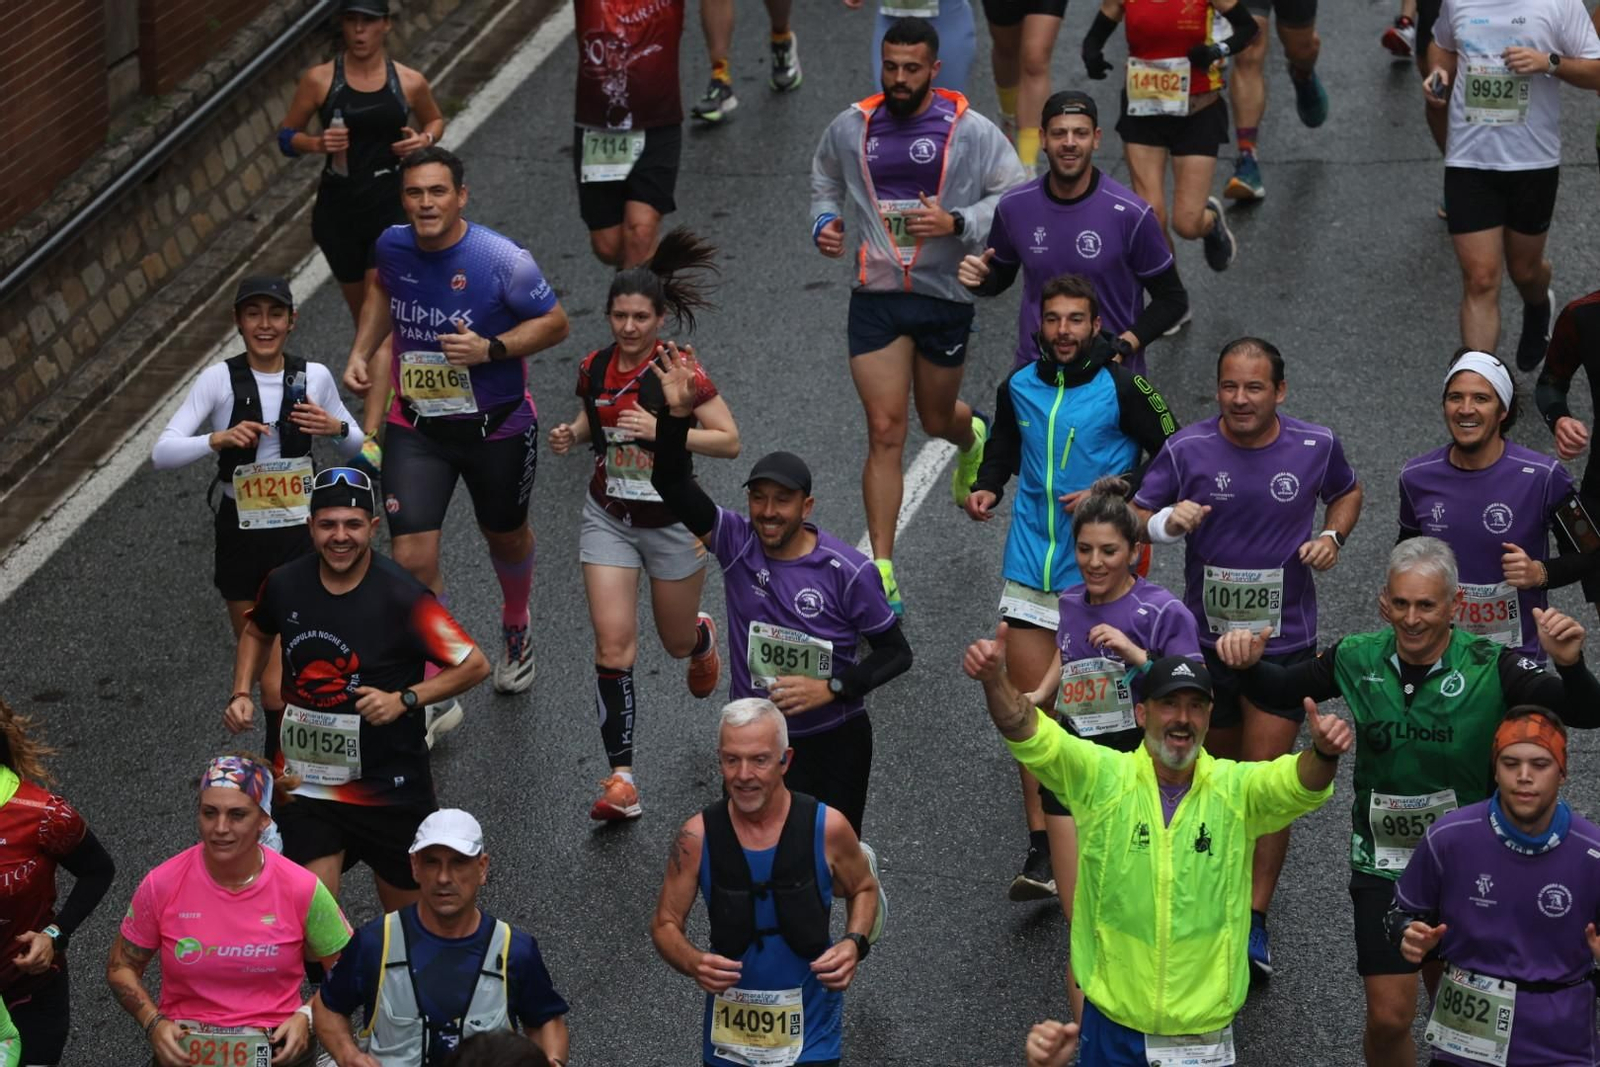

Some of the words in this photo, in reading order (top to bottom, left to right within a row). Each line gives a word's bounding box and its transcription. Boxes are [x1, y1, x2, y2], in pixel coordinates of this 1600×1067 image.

[1131, 73, 1179, 91] 14162
[1472, 79, 1514, 99] 9932
[591, 138, 629, 154] 7114
[405, 369, 459, 389] 12816
[242, 475, 302, 499] 11216
[1209, 585, 1269, 609] 10128
[289, 630, 317, 649] POPULAR
[318, 631, 341, 646] NOCHE
[340, 643, 350, 654] DE
[760, 642, 810, 669] 9851
[1063, 677, 1109, 704] 9937
[287, 725, 346, 754] 10152
[1395, 722, 1455, 743] Lhoist
[205, 944, 280, 957] run&fit
[1443, 986, 1491, 1023] 9852
[720, 1006, 786, 1034] 14091
[189, 1040, 248, 1066] 8216
